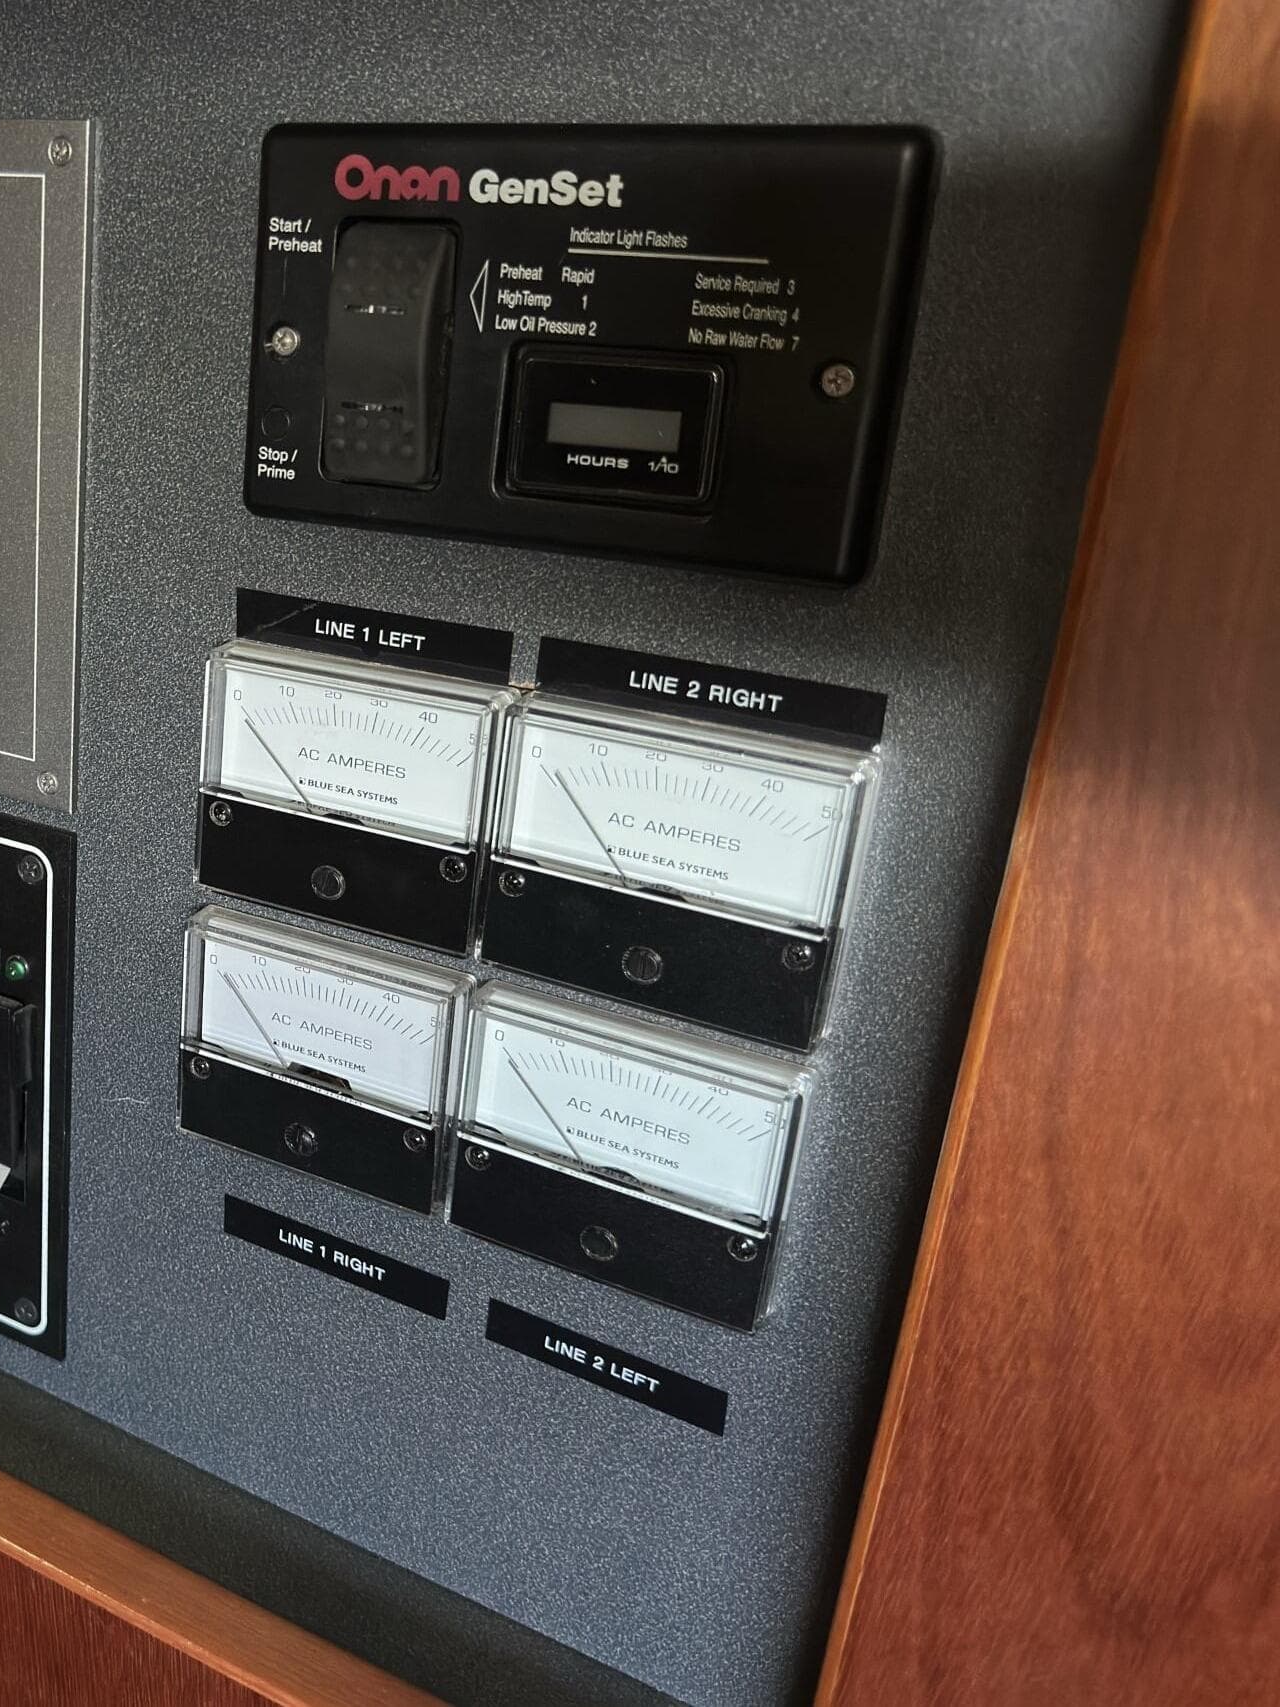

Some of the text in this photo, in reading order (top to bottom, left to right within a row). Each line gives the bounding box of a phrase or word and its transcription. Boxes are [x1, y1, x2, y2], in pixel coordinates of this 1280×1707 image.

[334, 154, 624, 209] Onan GenSet
[269, 217, 312, 233] Start /
[569, 226, 688, 249] Indicator Light Flashes
[268, 236, 322, 253] Preheat
[500, 263, 595, 287] Preheat Rapid
[694, 271, 796, 296] Service Required 3
[582, 294, 588, 311] 1
[691, 299, 800, 327] Excessive Cranking 4
[495, 314, 598, 337] Low Oil Pressure 2
[688, 327, 800, 352] No Raw Water Flow 7
[257, 463, 296, 480] Prime
[258, 446, 298, 465] Stop /
[567, 453, 680, 475] HOURS 1/10
[315, 618, 426, 652] LINE 1 LEFT
[233, 689, 242, 701] 0
[279, 685, 296, 698] 10
[324, 690, 343, 700] 20
[370, 699, 389, 709] 30
[418, 711, 438, 724] 40
[629, 670, 783, 713] LINE 2 RIGHT
[298, 746, 406, 779] AC AMPERES
[308, 779, 399, 805] BLUE SEA SYSTEMS
[531, 742, 842, 820] 0 10 20 30 40 50
[607, 811, 741, 852] AC AMPERES
[618, 847, 729, 881] BLUE SEA SYSTEMS
[210, 954, 218, 966] 0
[252, 955, 267, 967] 10
[382, 991, 400, 1004] 40
[272, 1011, 373, 1051] AC AMPERES
[495, 1029, 504, 1042] 0
[281, 1040, 366, 1073] BLUE SEA SYSTEMS
[565, 1096, 691, 1145] AC AMPERES
[576, 1129, 680, 1170] BLUE SEA SYSTEMS
[278, 1228, 386, 1281] LINE 1 RIGHT
[543, 1334, 660, 1393] LINE 2 LEFT
